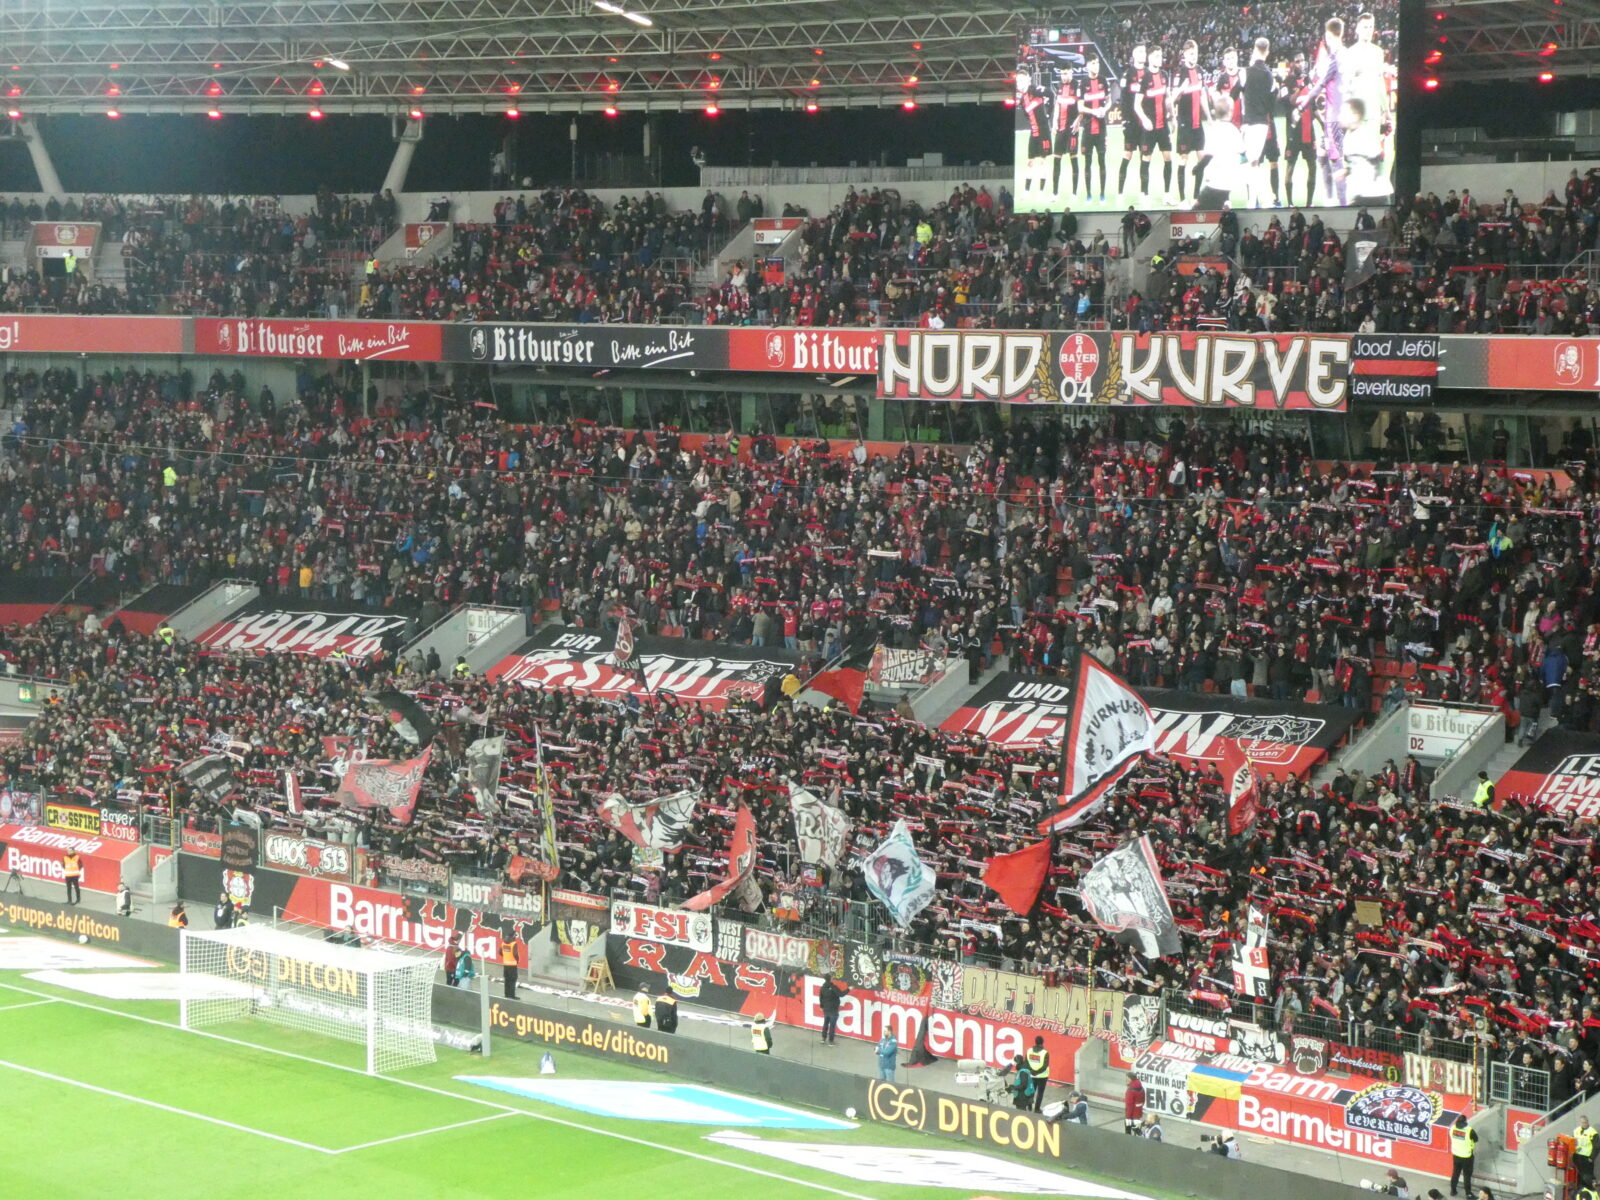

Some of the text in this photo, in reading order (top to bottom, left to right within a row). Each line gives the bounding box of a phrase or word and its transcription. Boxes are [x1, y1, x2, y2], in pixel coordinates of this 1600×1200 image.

[237, 320, 324, 356] Bitburger
[338, 324, 409, 356] Bitte ein Bit
[493, 326, 595, 364] Bitburger
[611, 331, 695, 364] Bitte ein Bit
[793, 331, 878, 371] Bitbur
[1353, 339, 1392, 356] Jood
[883, 332, 1349, 408] NORD KURVE
[1060, 353, 1098, 365] BAYER
[1060, 376, 1094, 403] 04
[1351, 378, 1431, 397] Leverkusen
[550, 632, 602, 651] FÜR
[1007, 681, 1070, 702] UND
[1410, 736, 1425, 751] D2
[47, 808, 100, 832] CROSSFIRE
[100, 807, 135, 827] Bayer
[11, 826, 103, 854] Barmenia
[633, 906, 690, 944] FSI
[717, 920, 742, 937] WEST
[717, 934, 742, 950] SIDE
[276, 955, 357, 996] DITCON
[488, 1003, 669, 1064] fc-gruppe.de/ditcon
[1168, 1010, 1229, 1039] YOUNG
[1173, 1030, 1217, 1052] BOYS
[1135, 1052, 1173, 1074] DER
[1403, 1050, 1431, 1089] LEV
[1446, 1059, 1483, 1097] ELITE
[1136, 1071, 1186, 1090] GEHT MIR AUF
[938, 1097, 1060, 1158] DITCON
[1347, 1112, 1429, 1141] LEVERKUSEN
